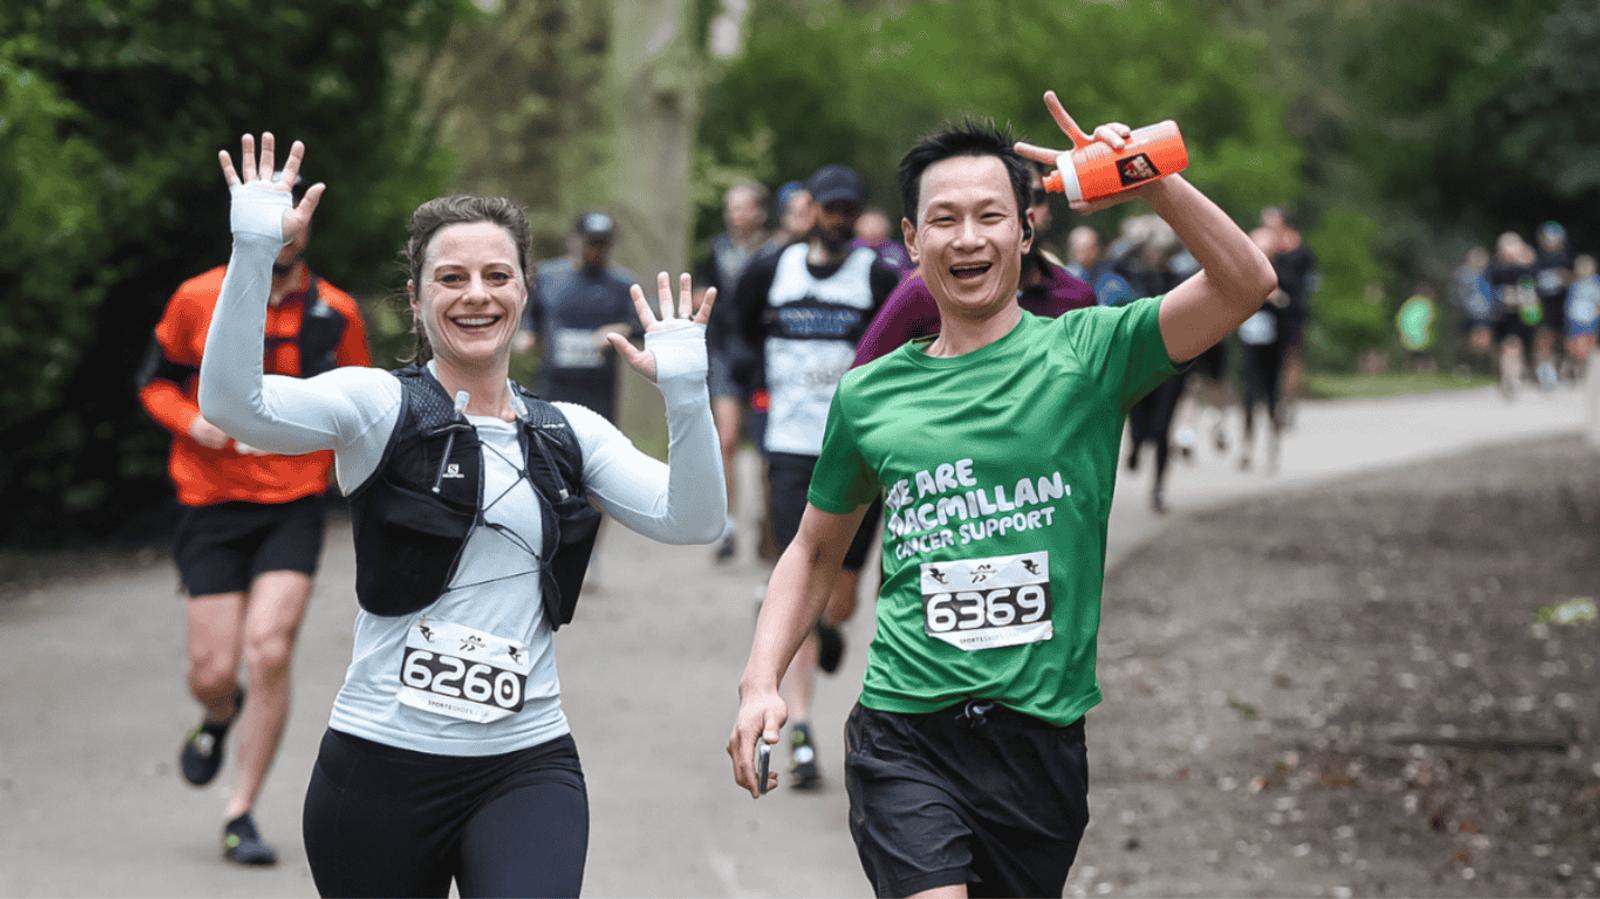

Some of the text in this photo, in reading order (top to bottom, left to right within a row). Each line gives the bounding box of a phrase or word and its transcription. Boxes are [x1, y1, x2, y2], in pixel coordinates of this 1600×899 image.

[915, 458, 977, 498] ARE
[896, 506, 1055, 560] CANCER SUPPORT
[927, 584, 1046, 632] 6369
[402, 649, 521, 708] 6260
